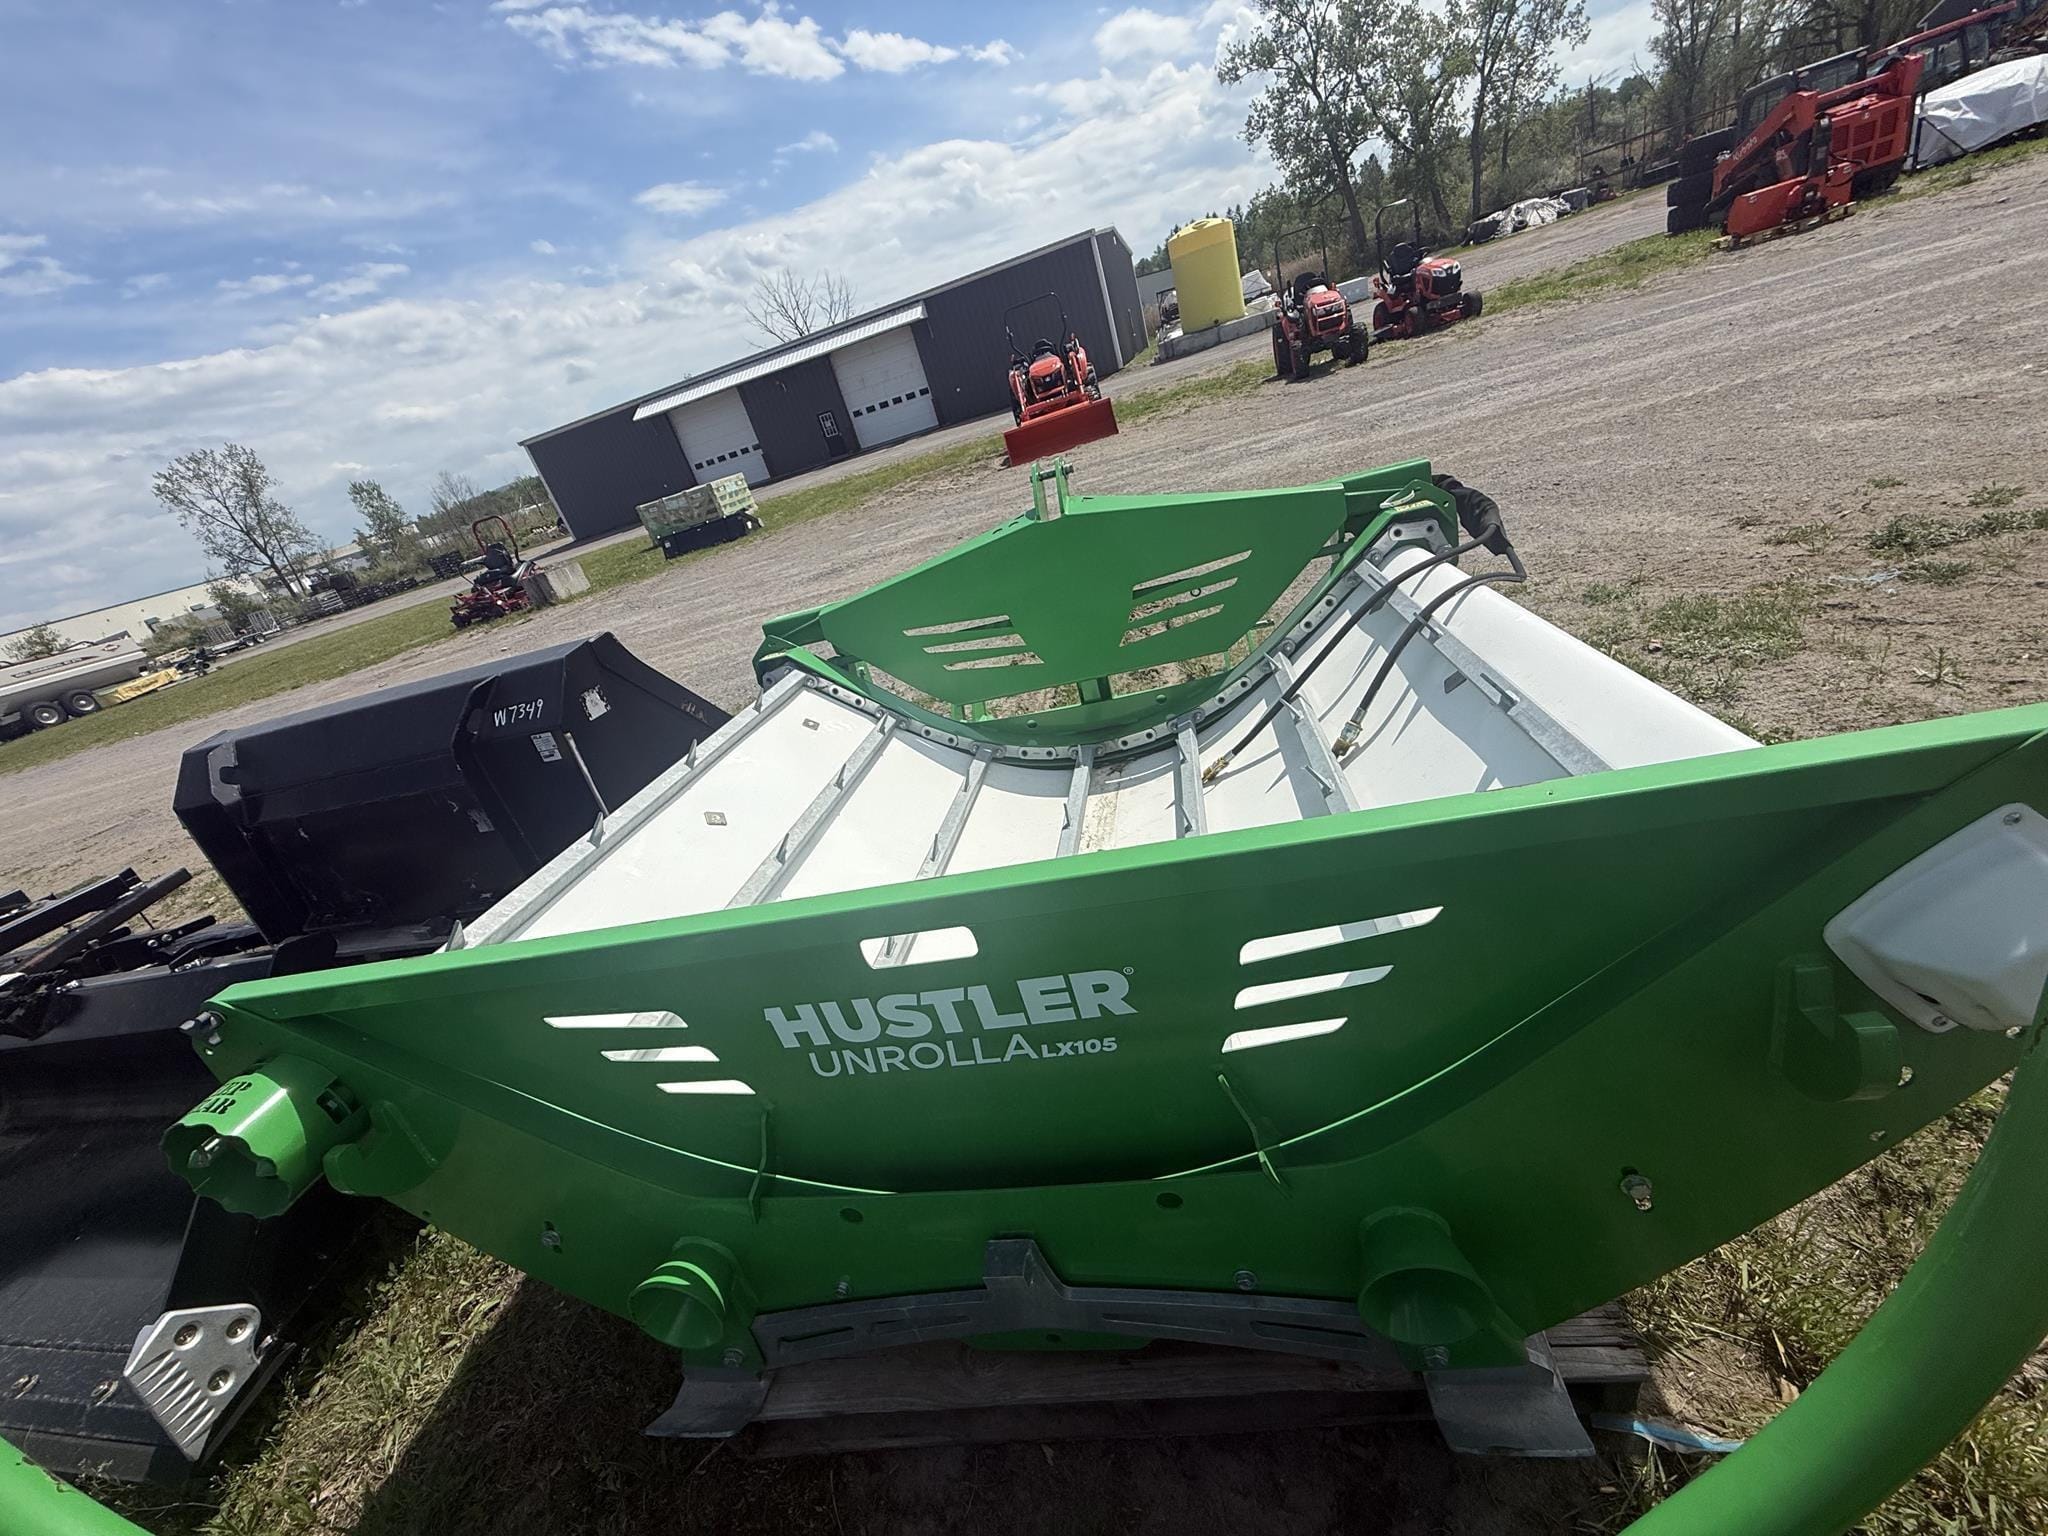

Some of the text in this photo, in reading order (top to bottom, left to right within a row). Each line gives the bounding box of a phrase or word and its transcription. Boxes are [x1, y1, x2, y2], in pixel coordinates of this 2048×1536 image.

[494, 698, 544, 728] W7349
[808, 1033, 1118, 1078] UNROLLA LX105
